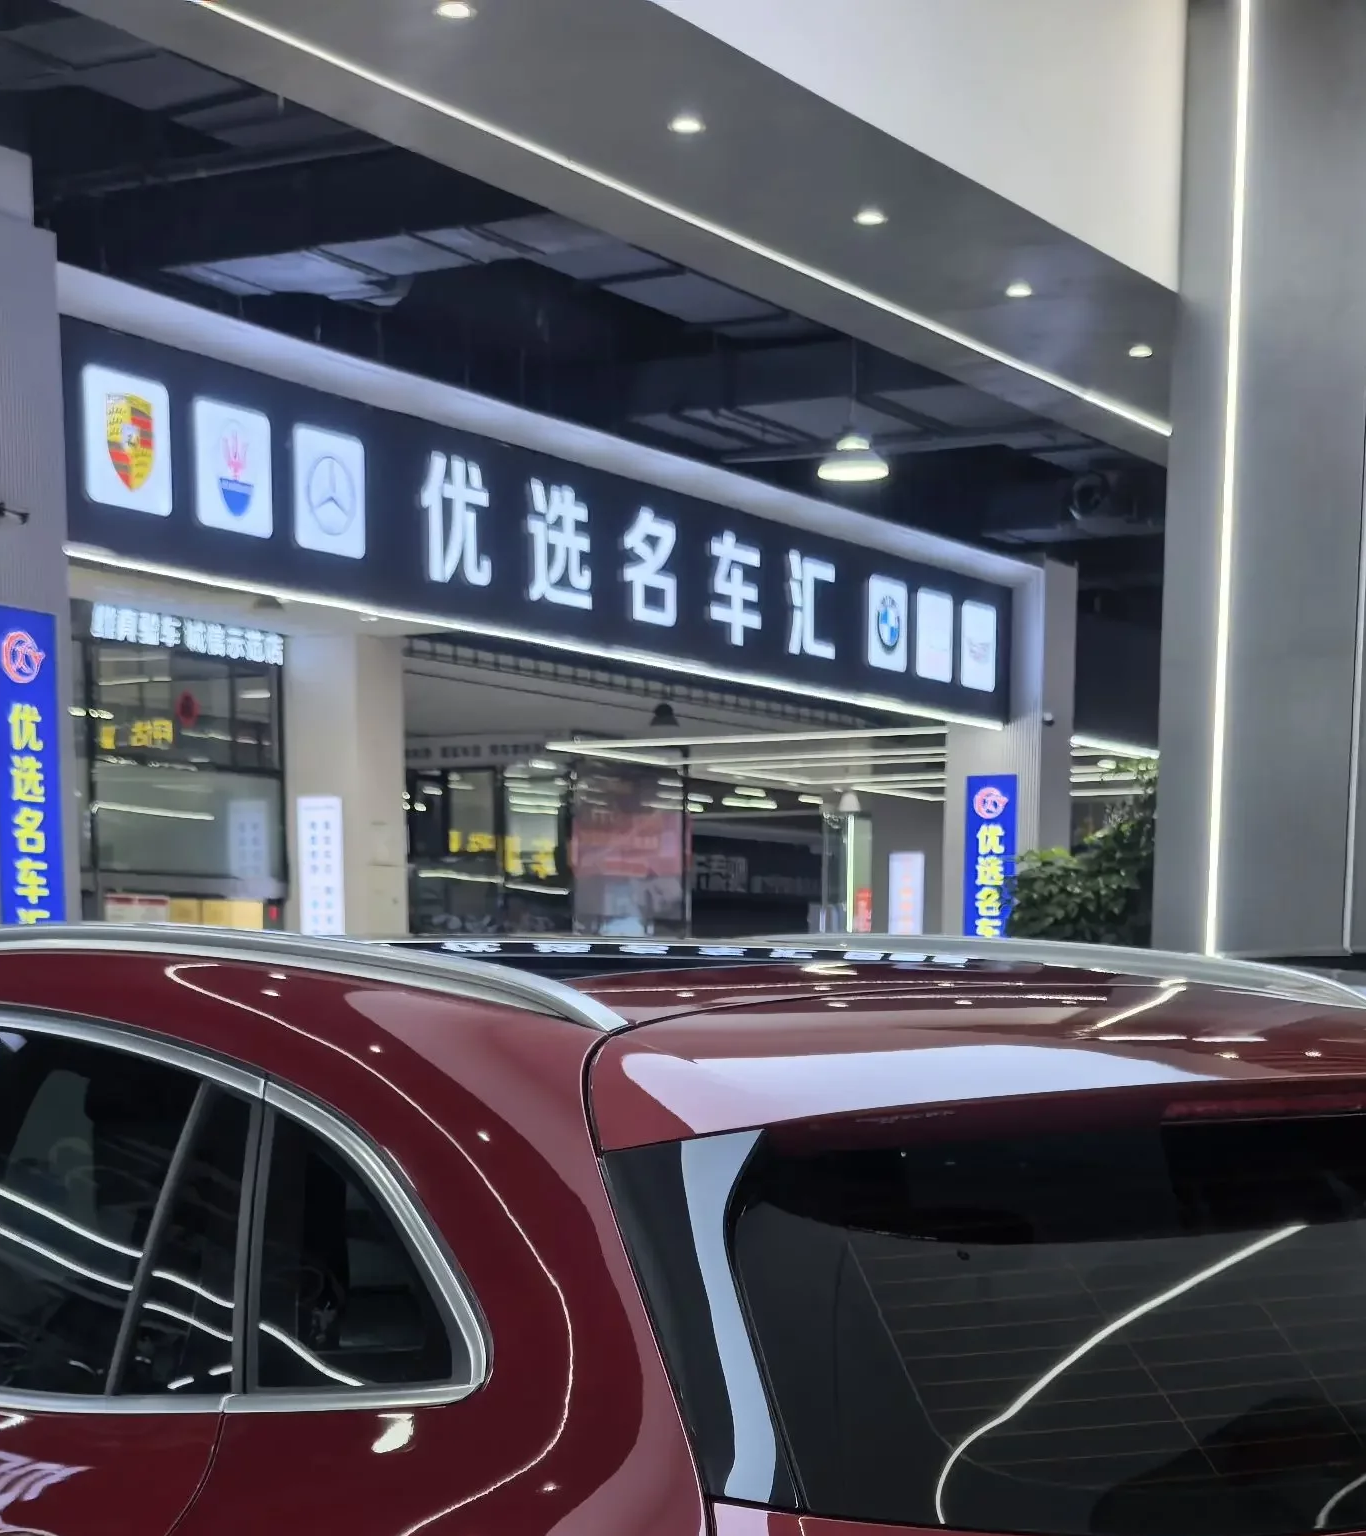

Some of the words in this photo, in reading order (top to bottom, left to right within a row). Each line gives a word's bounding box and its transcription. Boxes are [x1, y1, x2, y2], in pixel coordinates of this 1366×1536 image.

[420, 450, 835, 660] 优选名车汇
